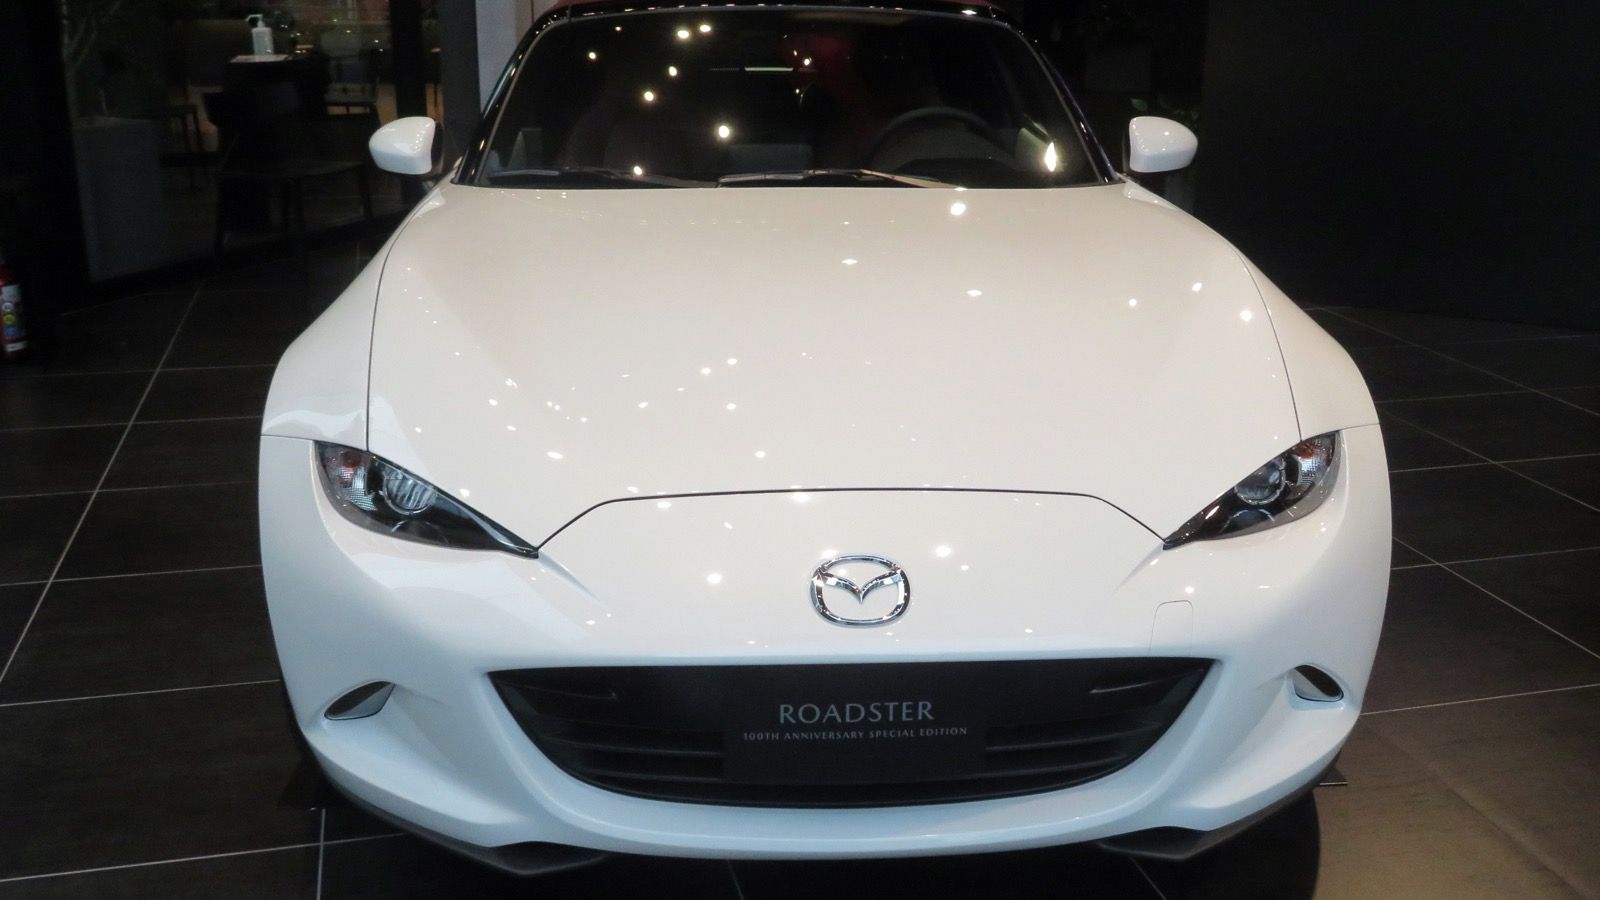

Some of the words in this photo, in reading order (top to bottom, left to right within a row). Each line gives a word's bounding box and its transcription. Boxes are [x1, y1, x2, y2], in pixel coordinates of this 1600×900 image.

[779, 701, 934, 724] ROADSTER
[743, 731, 780, 741] 100TH
[784, 730, 864, 740] ANNIVERSARY
[869, 728, 915, 739] SPECIAL
[919, 727, 968, 737] EDITION
